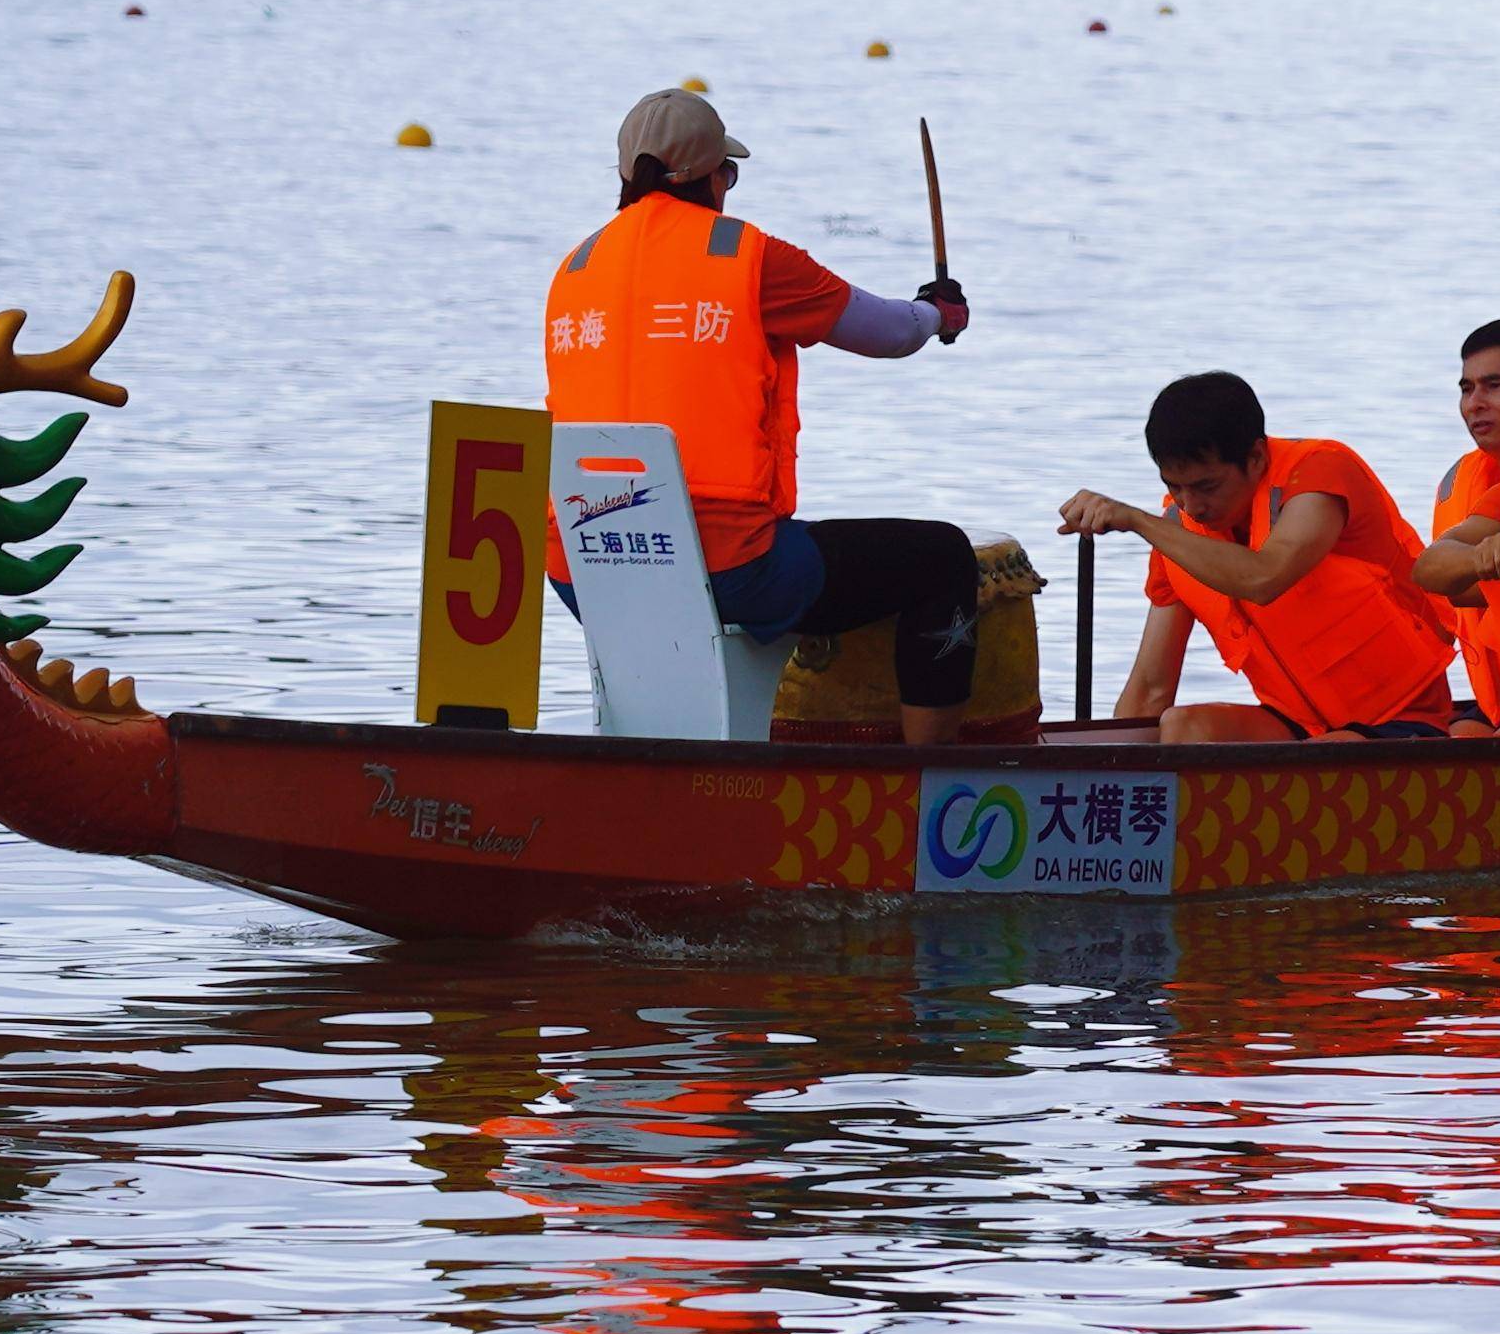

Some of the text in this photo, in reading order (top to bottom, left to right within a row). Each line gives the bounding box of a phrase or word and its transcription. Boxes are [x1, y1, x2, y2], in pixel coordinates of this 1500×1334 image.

[550, 300, 735, 356] 珠海 三防
[446, 439, 524, 645] 5
[578, 531, 675, 554] 上海培生
[583, 555, 674, 566] www.ps-boat.com
[691, 772, 765, 800] PS16020
[410, 798, 472, 848] 培生
[1037, 783, 1168, 846] 大横琴
[1035, 857, 1164, 884] DA HENG QIN
